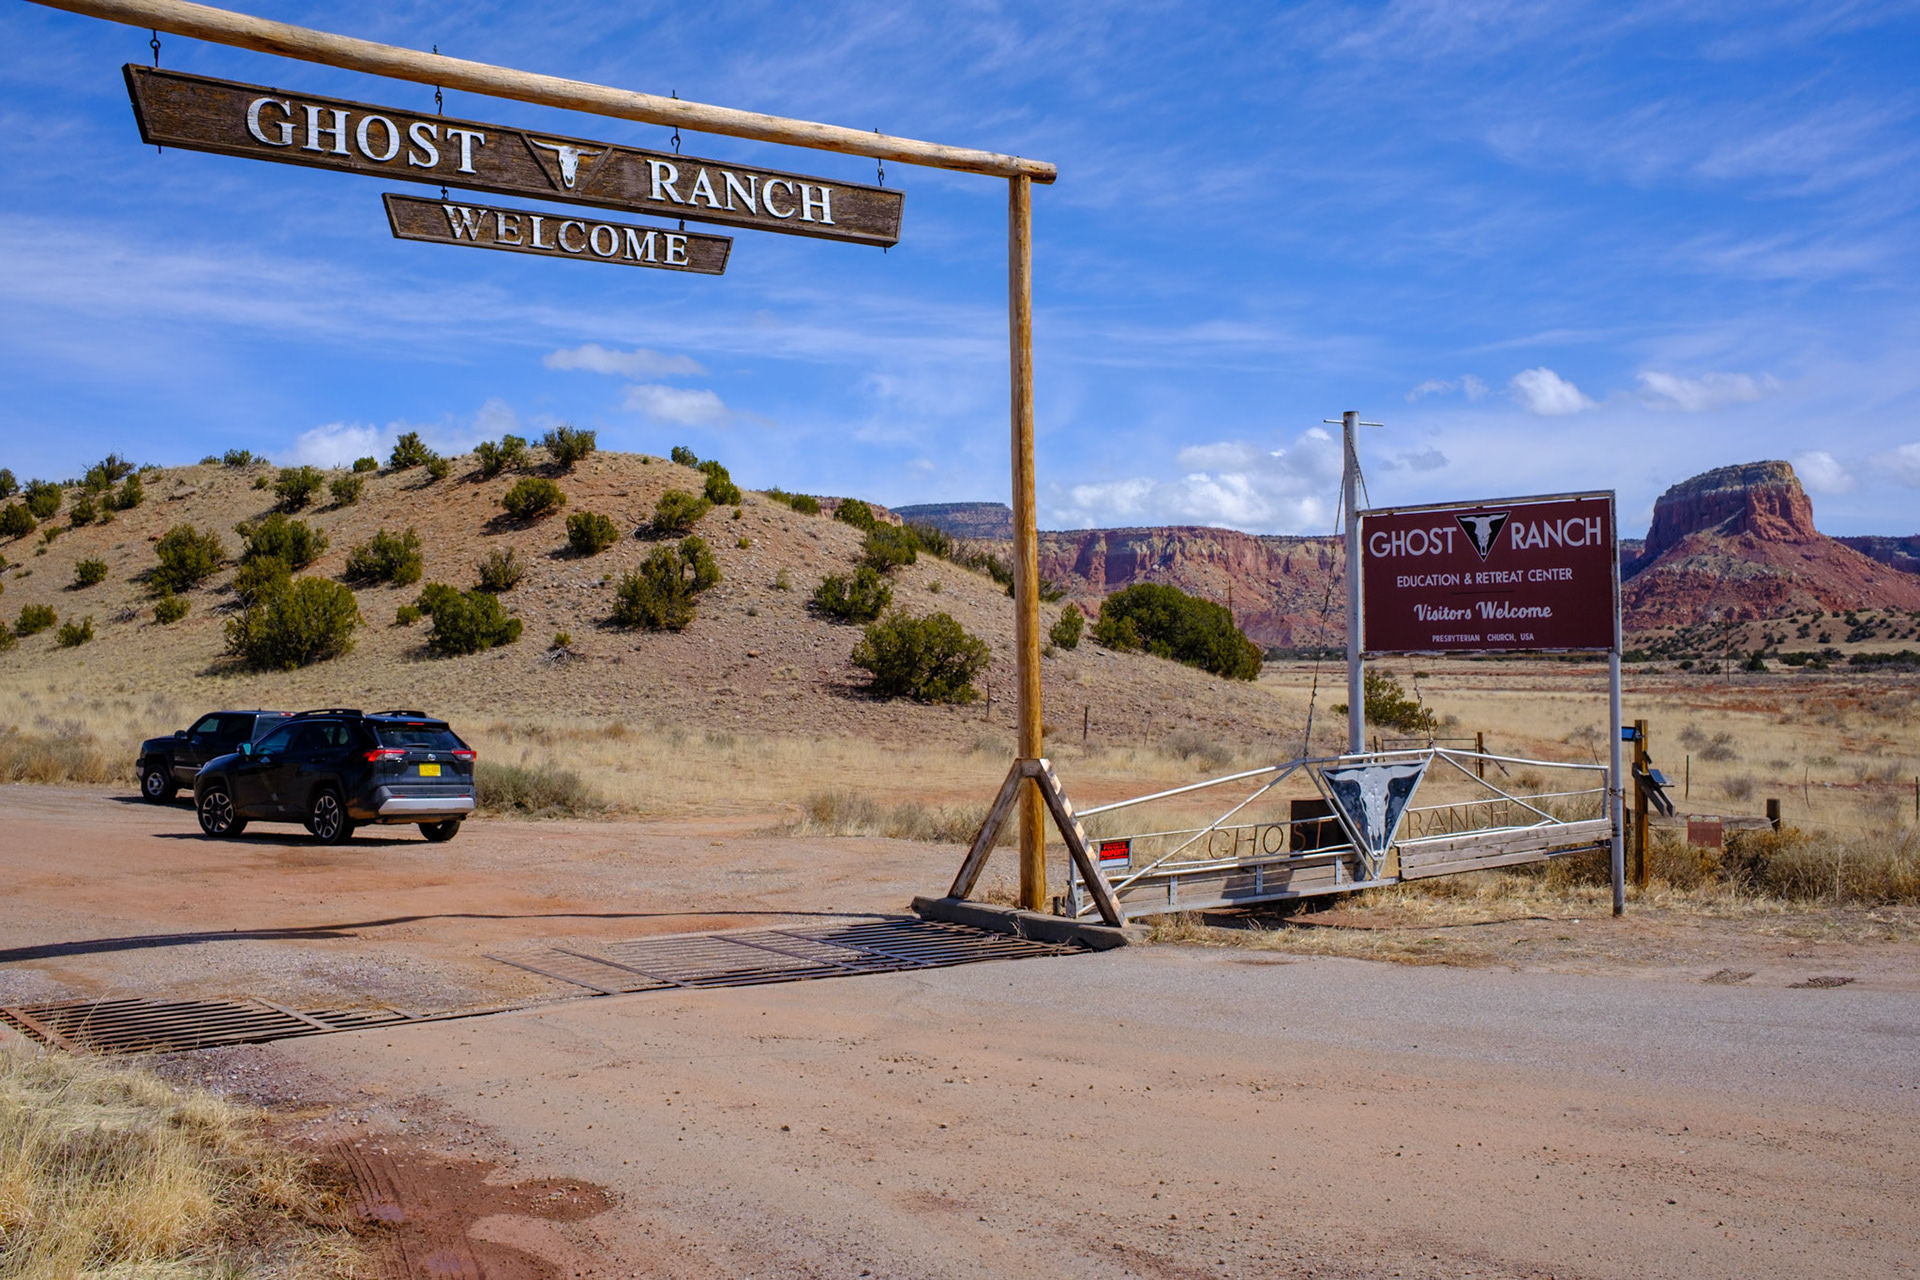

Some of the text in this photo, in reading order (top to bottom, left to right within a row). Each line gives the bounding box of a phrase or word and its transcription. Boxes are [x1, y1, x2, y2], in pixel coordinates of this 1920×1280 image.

[246, 97, 835, 225] GHOST RANCH
[442, 204, 689, 266] WELCOME
[1369, 517, 1601, 558] GHOST RANCH
[1397, 568, 1573, 588] EDUCATION & RETREAT CENTER
[1413, 601, 1553, 622] Visitors Welcome
[1432, 633, 1535, 643] PRESBYTERIAN CHURCH, USA
[1208, 800, 1509, 860] GHOST RANCH
